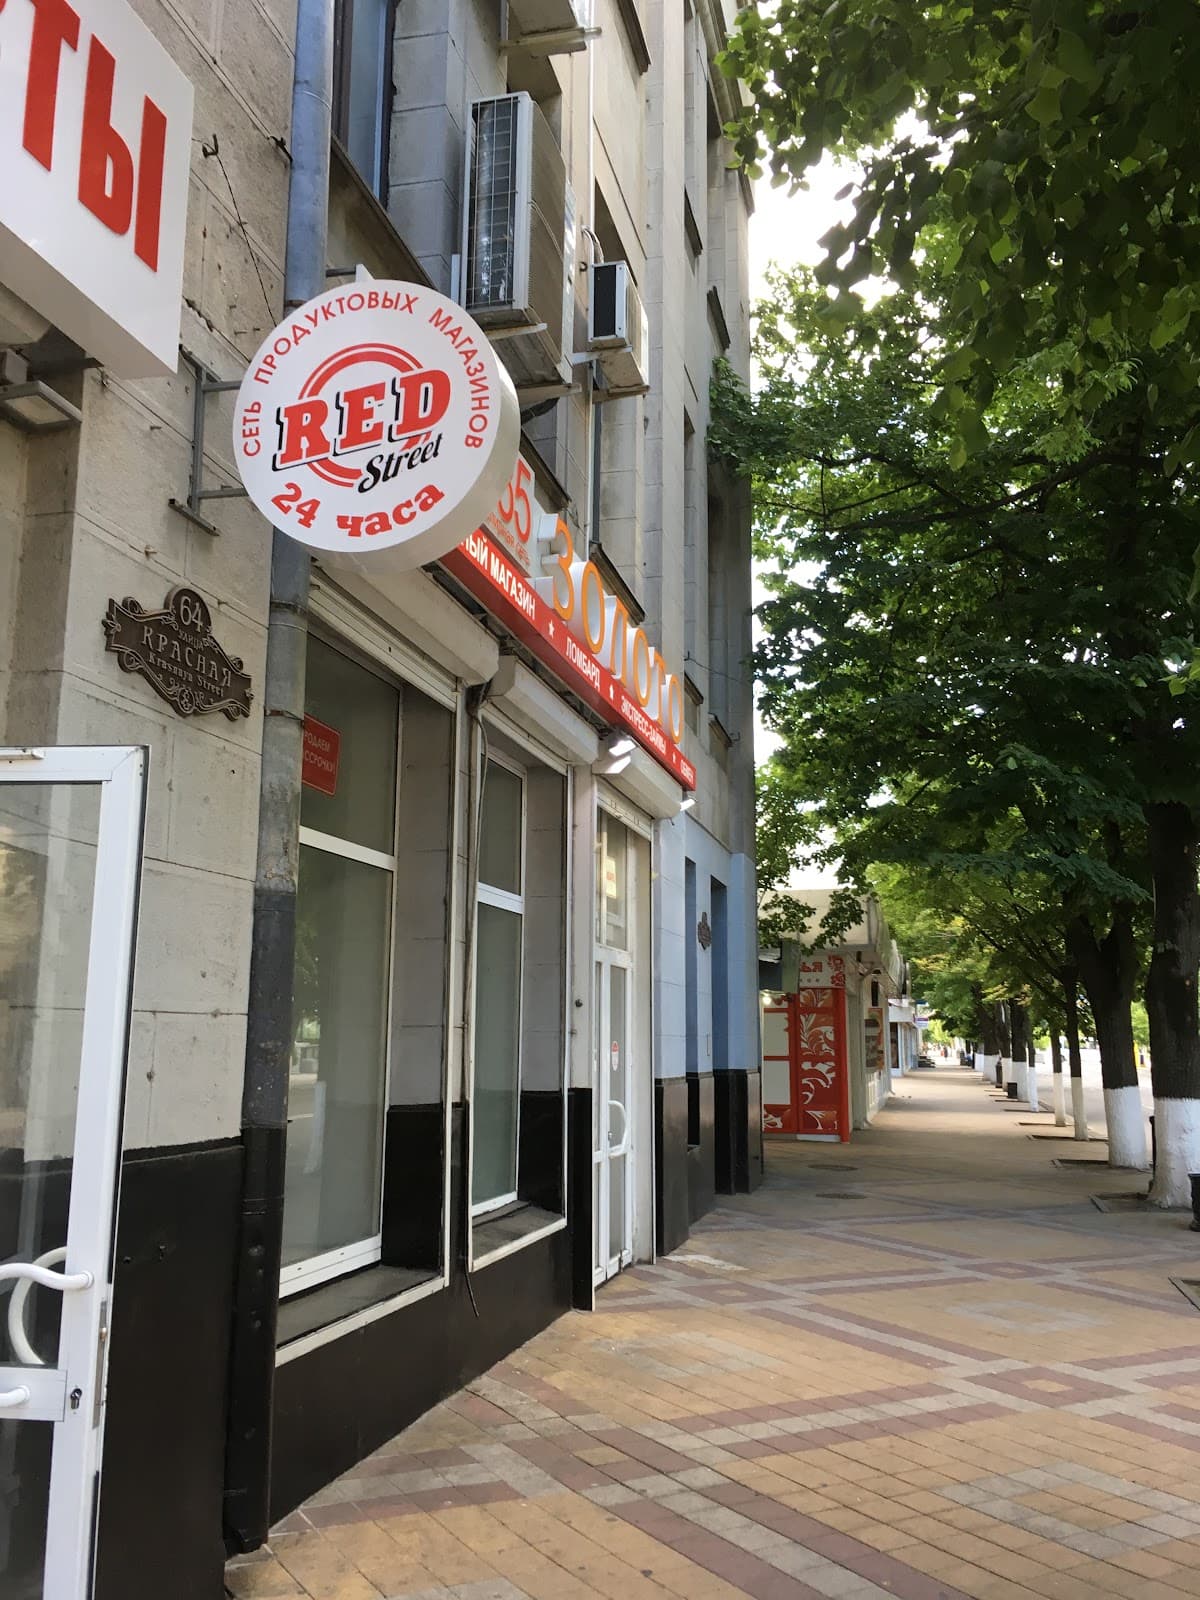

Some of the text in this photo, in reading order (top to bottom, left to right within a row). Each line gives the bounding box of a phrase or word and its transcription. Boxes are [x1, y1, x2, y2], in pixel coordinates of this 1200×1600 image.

[0, 0, 168, 273] ТЫ
[242, 291, 490, 457] СЕТЬ ПРОДУКТОВЫХ МАГАЗИНОВ
[273, 369, 451, 471] RED
[271, 482, 321, 529] 24
[336, 484, 446, 538] часа
[357, 432, 443, 494] Street
[142, 625, 232, 687] КРАСНАЯ
[180, 595, 204, 633] 64
[490, 551, 536, 621] МАГАЗИН
[565, 637, 601, 693] ЛОМБАРД
[552, 517, 684, 744] ЗОЛОТО
